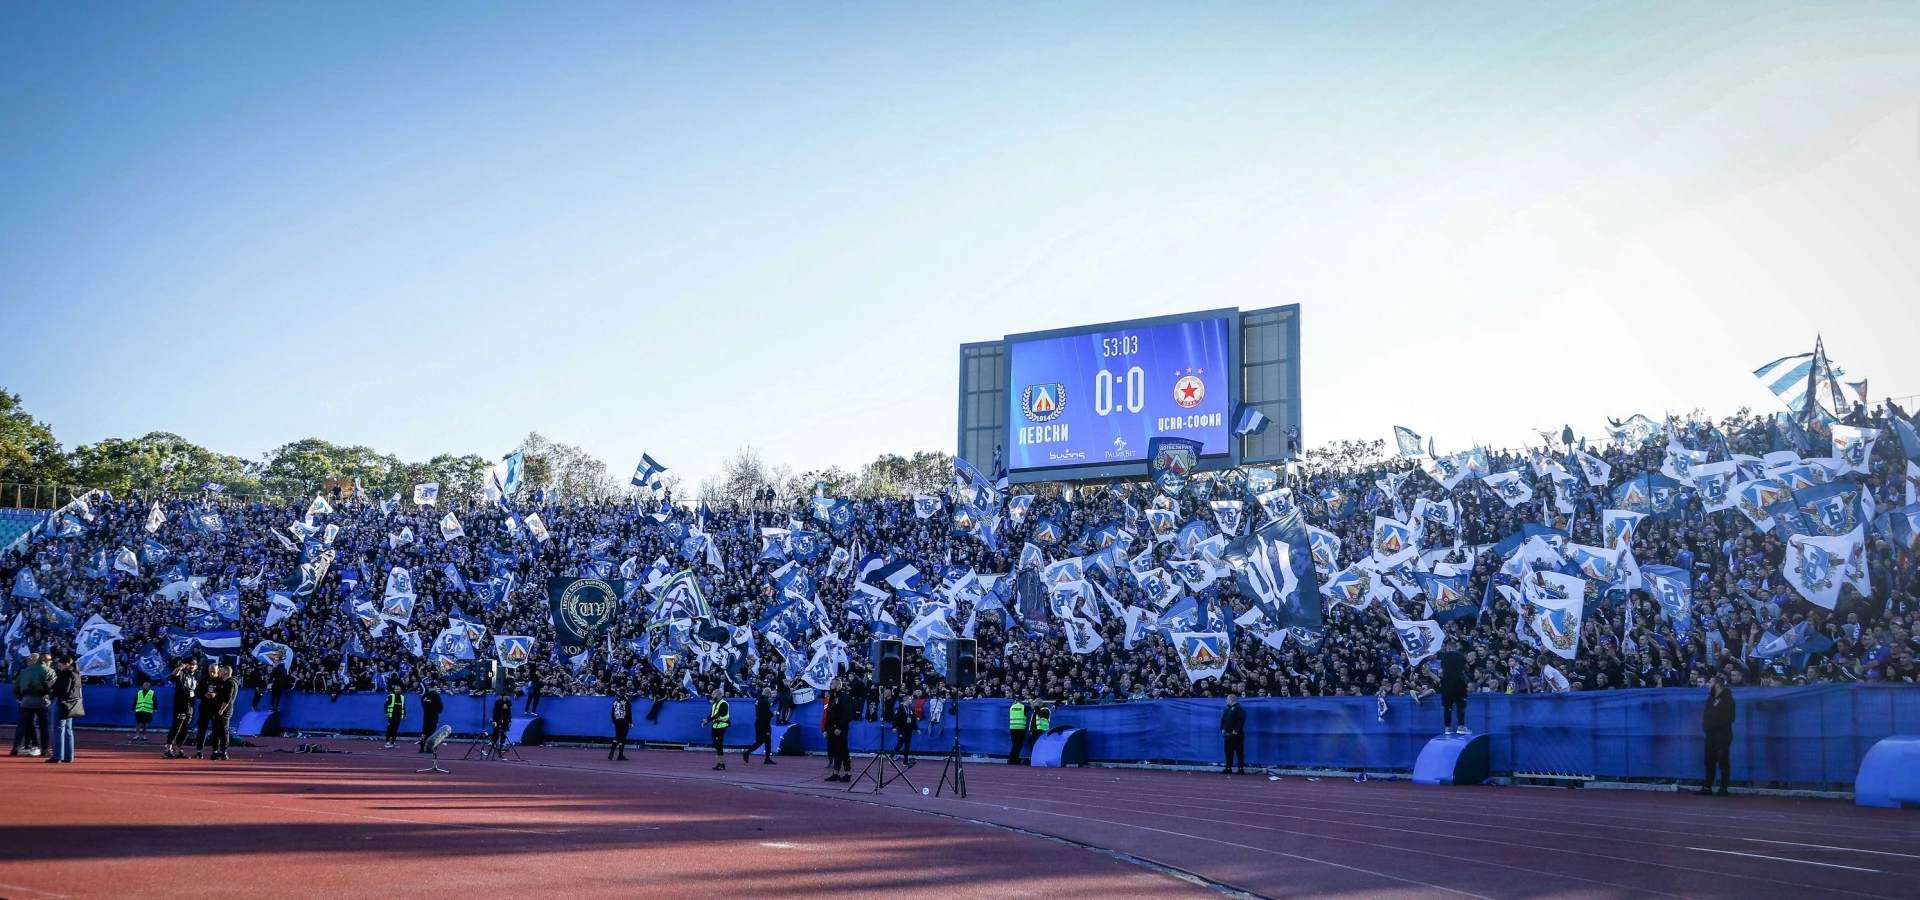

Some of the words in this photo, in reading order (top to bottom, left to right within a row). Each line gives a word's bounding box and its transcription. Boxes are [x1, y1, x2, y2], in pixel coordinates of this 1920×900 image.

[1103, 335, 1138, 357] 53:03
[1095, 366, 1145, 416] 0:0
[1158, 413, 1222, 432] ЦСКА-СОФИЯ
[1019, 424, 1069, 445] ЛЕВСКИ
[1125, 449, 1137, 457] BET
[1708, 480, 1721, 495] Б
[1827, 504, 1842, 524] Б
[562, 591, 571, 610] LEVSKI
[569, 582, 585, 593] SOFIA
[1400, 632, 1420, 650] Б
